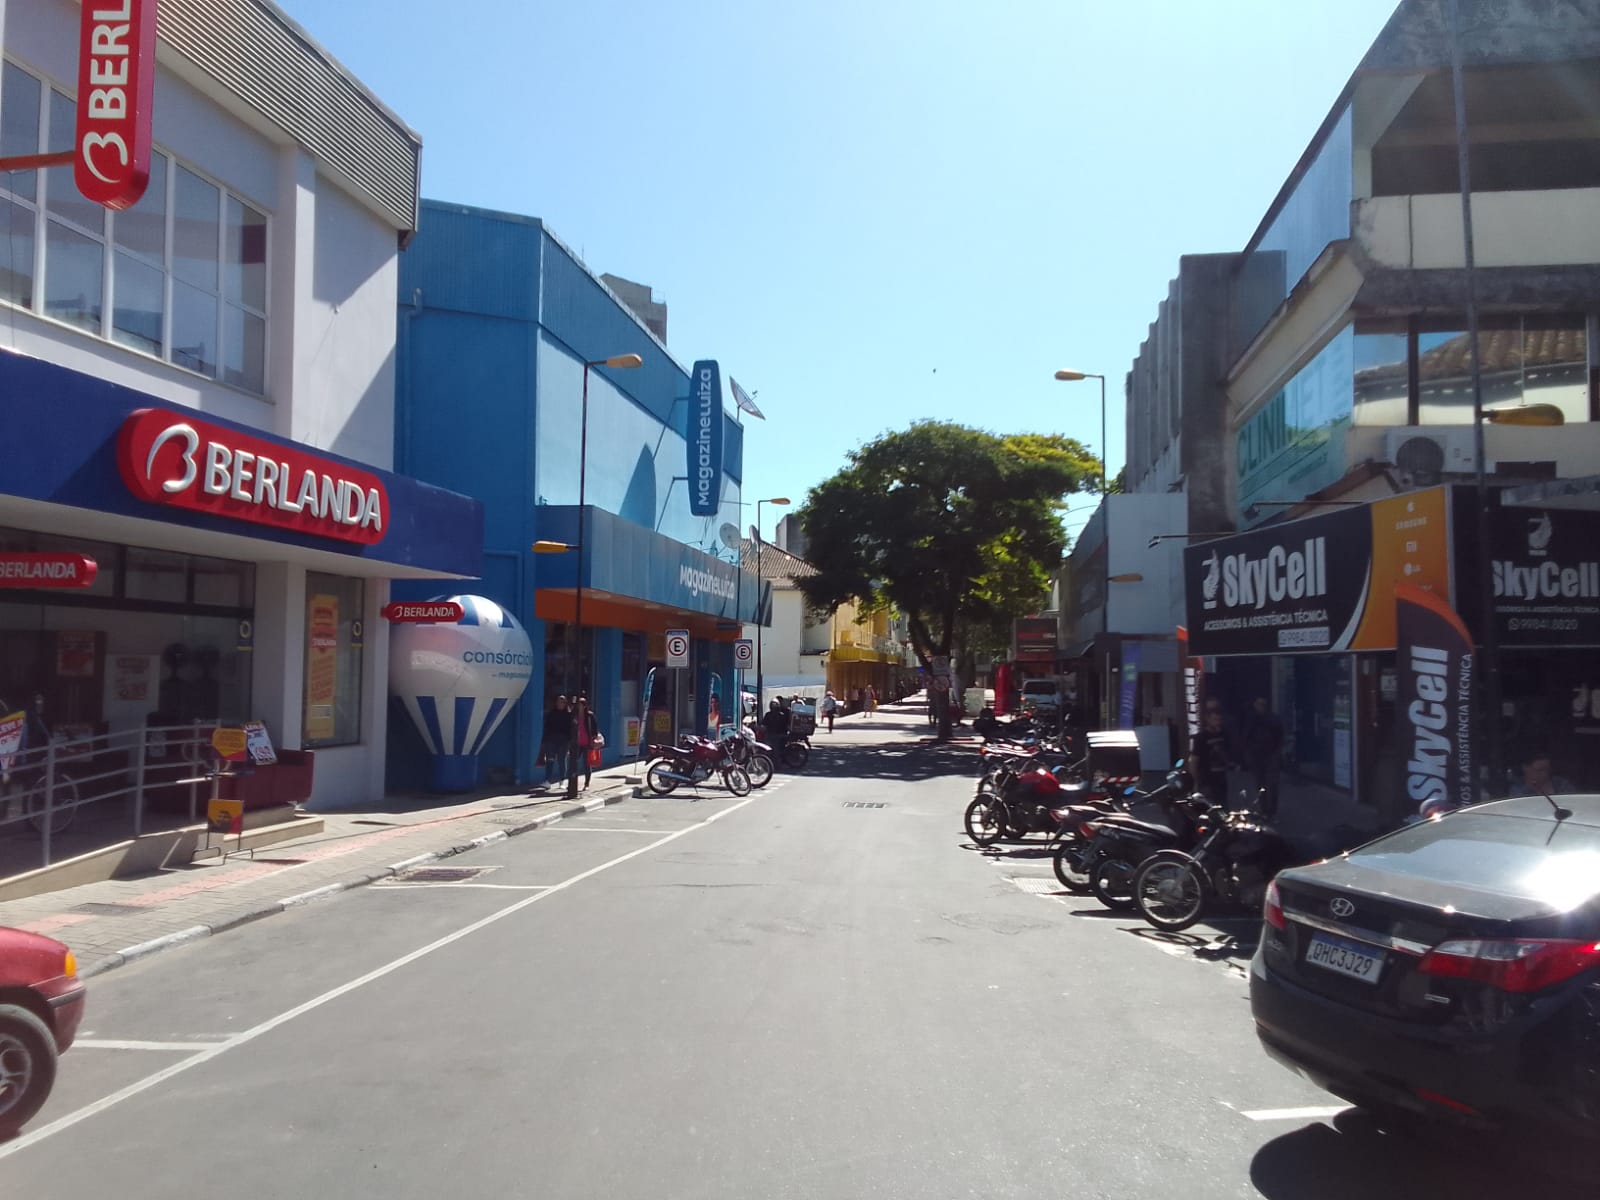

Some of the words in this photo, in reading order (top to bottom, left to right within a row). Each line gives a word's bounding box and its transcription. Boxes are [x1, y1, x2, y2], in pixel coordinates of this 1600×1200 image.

[203, 441, 383, 532] BERLANDA
[1222, 536, 1327, 610] SkyCell
[1491, 560, 1600, 601] SkyCell
[403, 606, 455, 618] BERLANDA
[1294, 609, 1329, 624] TÉCNICA
[673, 641, 681, 653] E
[740, 648, 747, 657] E
[1458, 653, 1473, 702] TÉCNICA
[1408, 645, 1452, 801] SkyCell
[1456, 703, 1471, 774] ASSISTÊNCIA
[1312, 942, 1374, 977] QHC3J29
